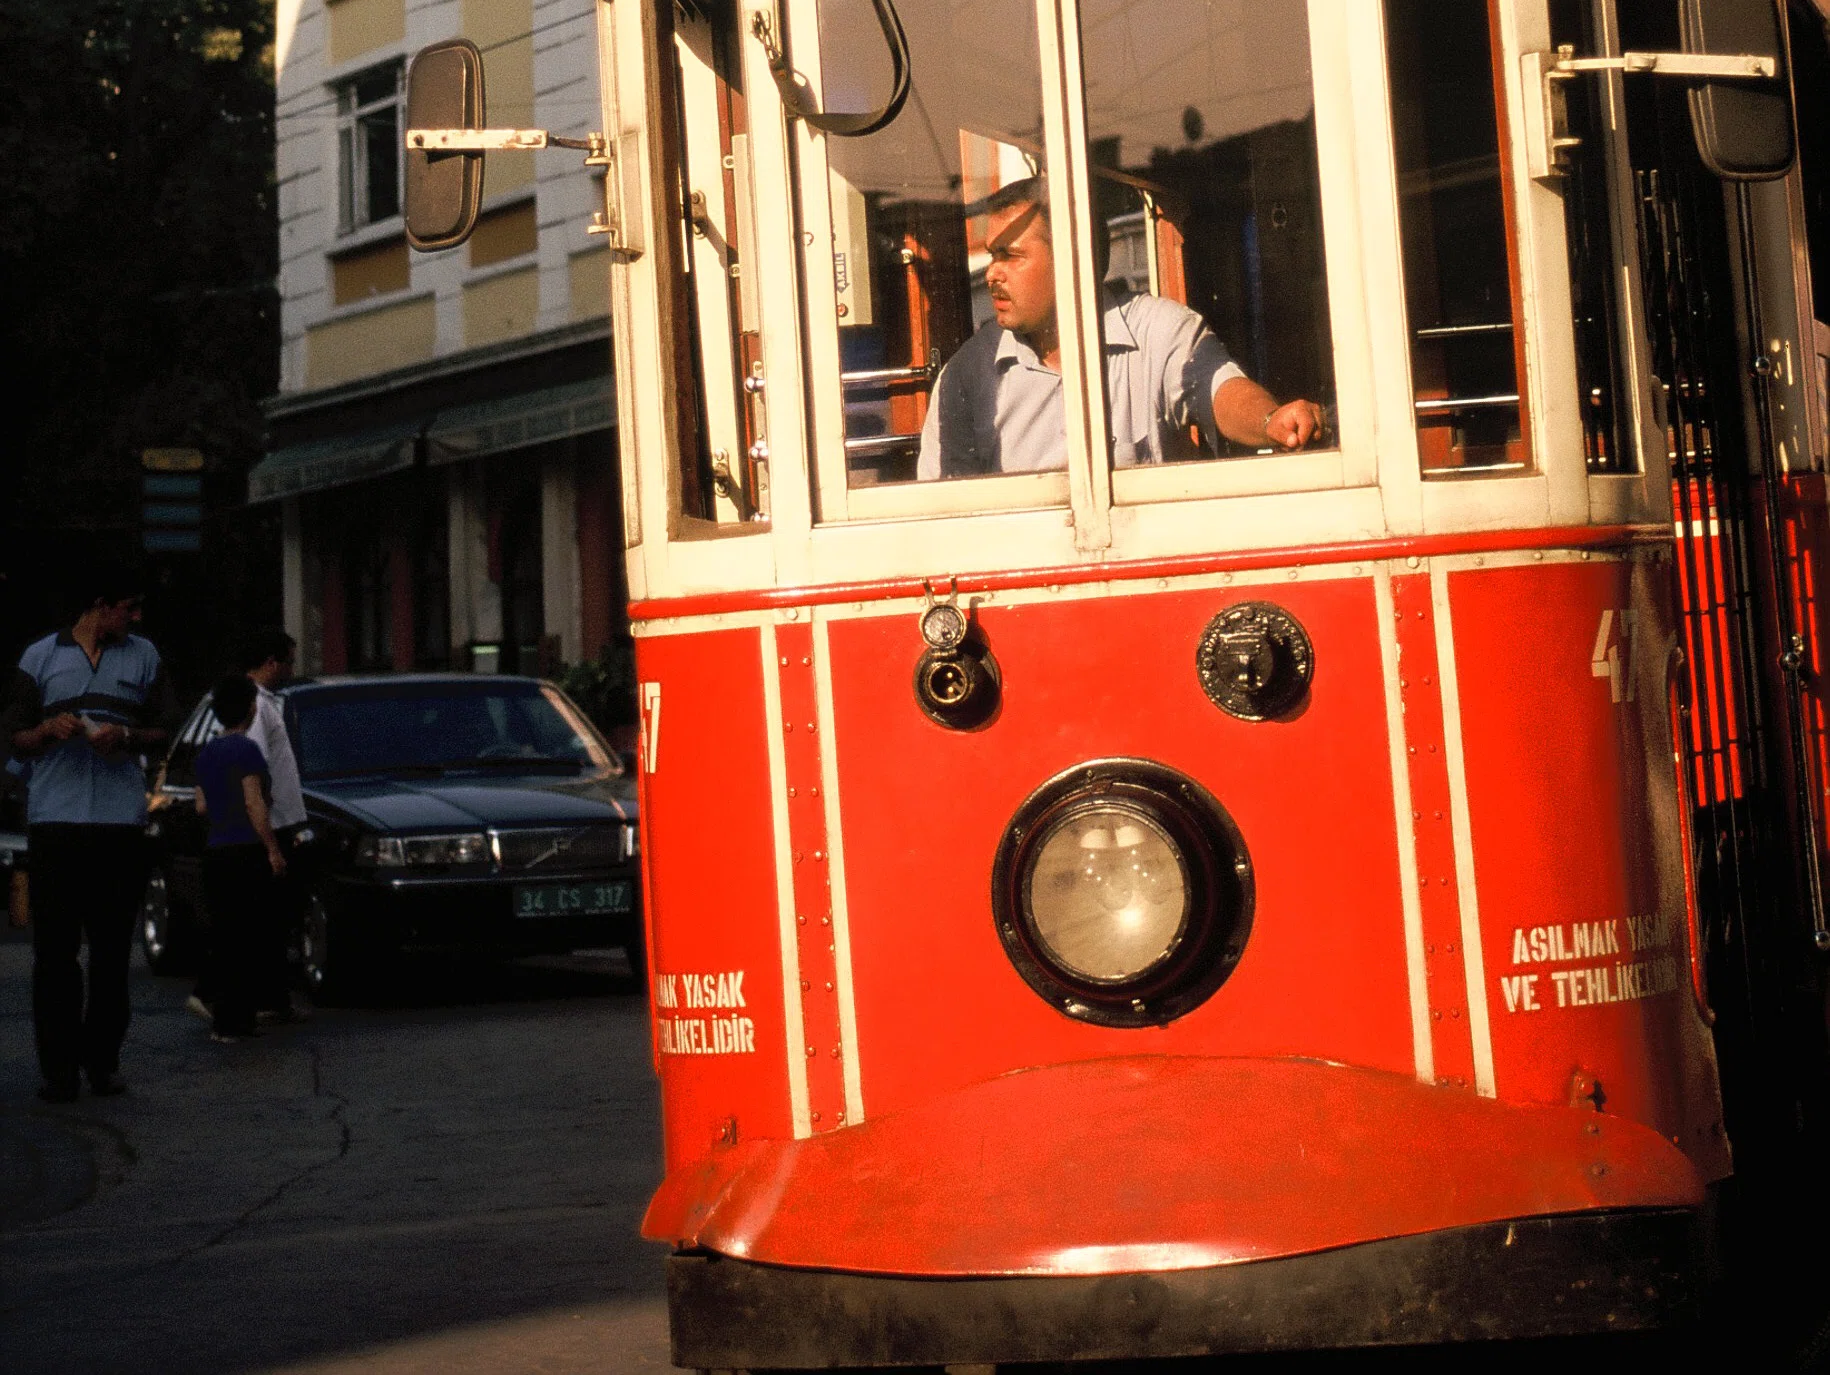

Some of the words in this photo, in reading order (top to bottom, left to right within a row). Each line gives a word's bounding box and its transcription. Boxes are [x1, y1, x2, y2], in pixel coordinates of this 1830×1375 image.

[1512, 919, 1620, 964] ASILMAK
[682, 970, 747, 1008] YASAK
[1500, 974, 1541, 1013] VE
